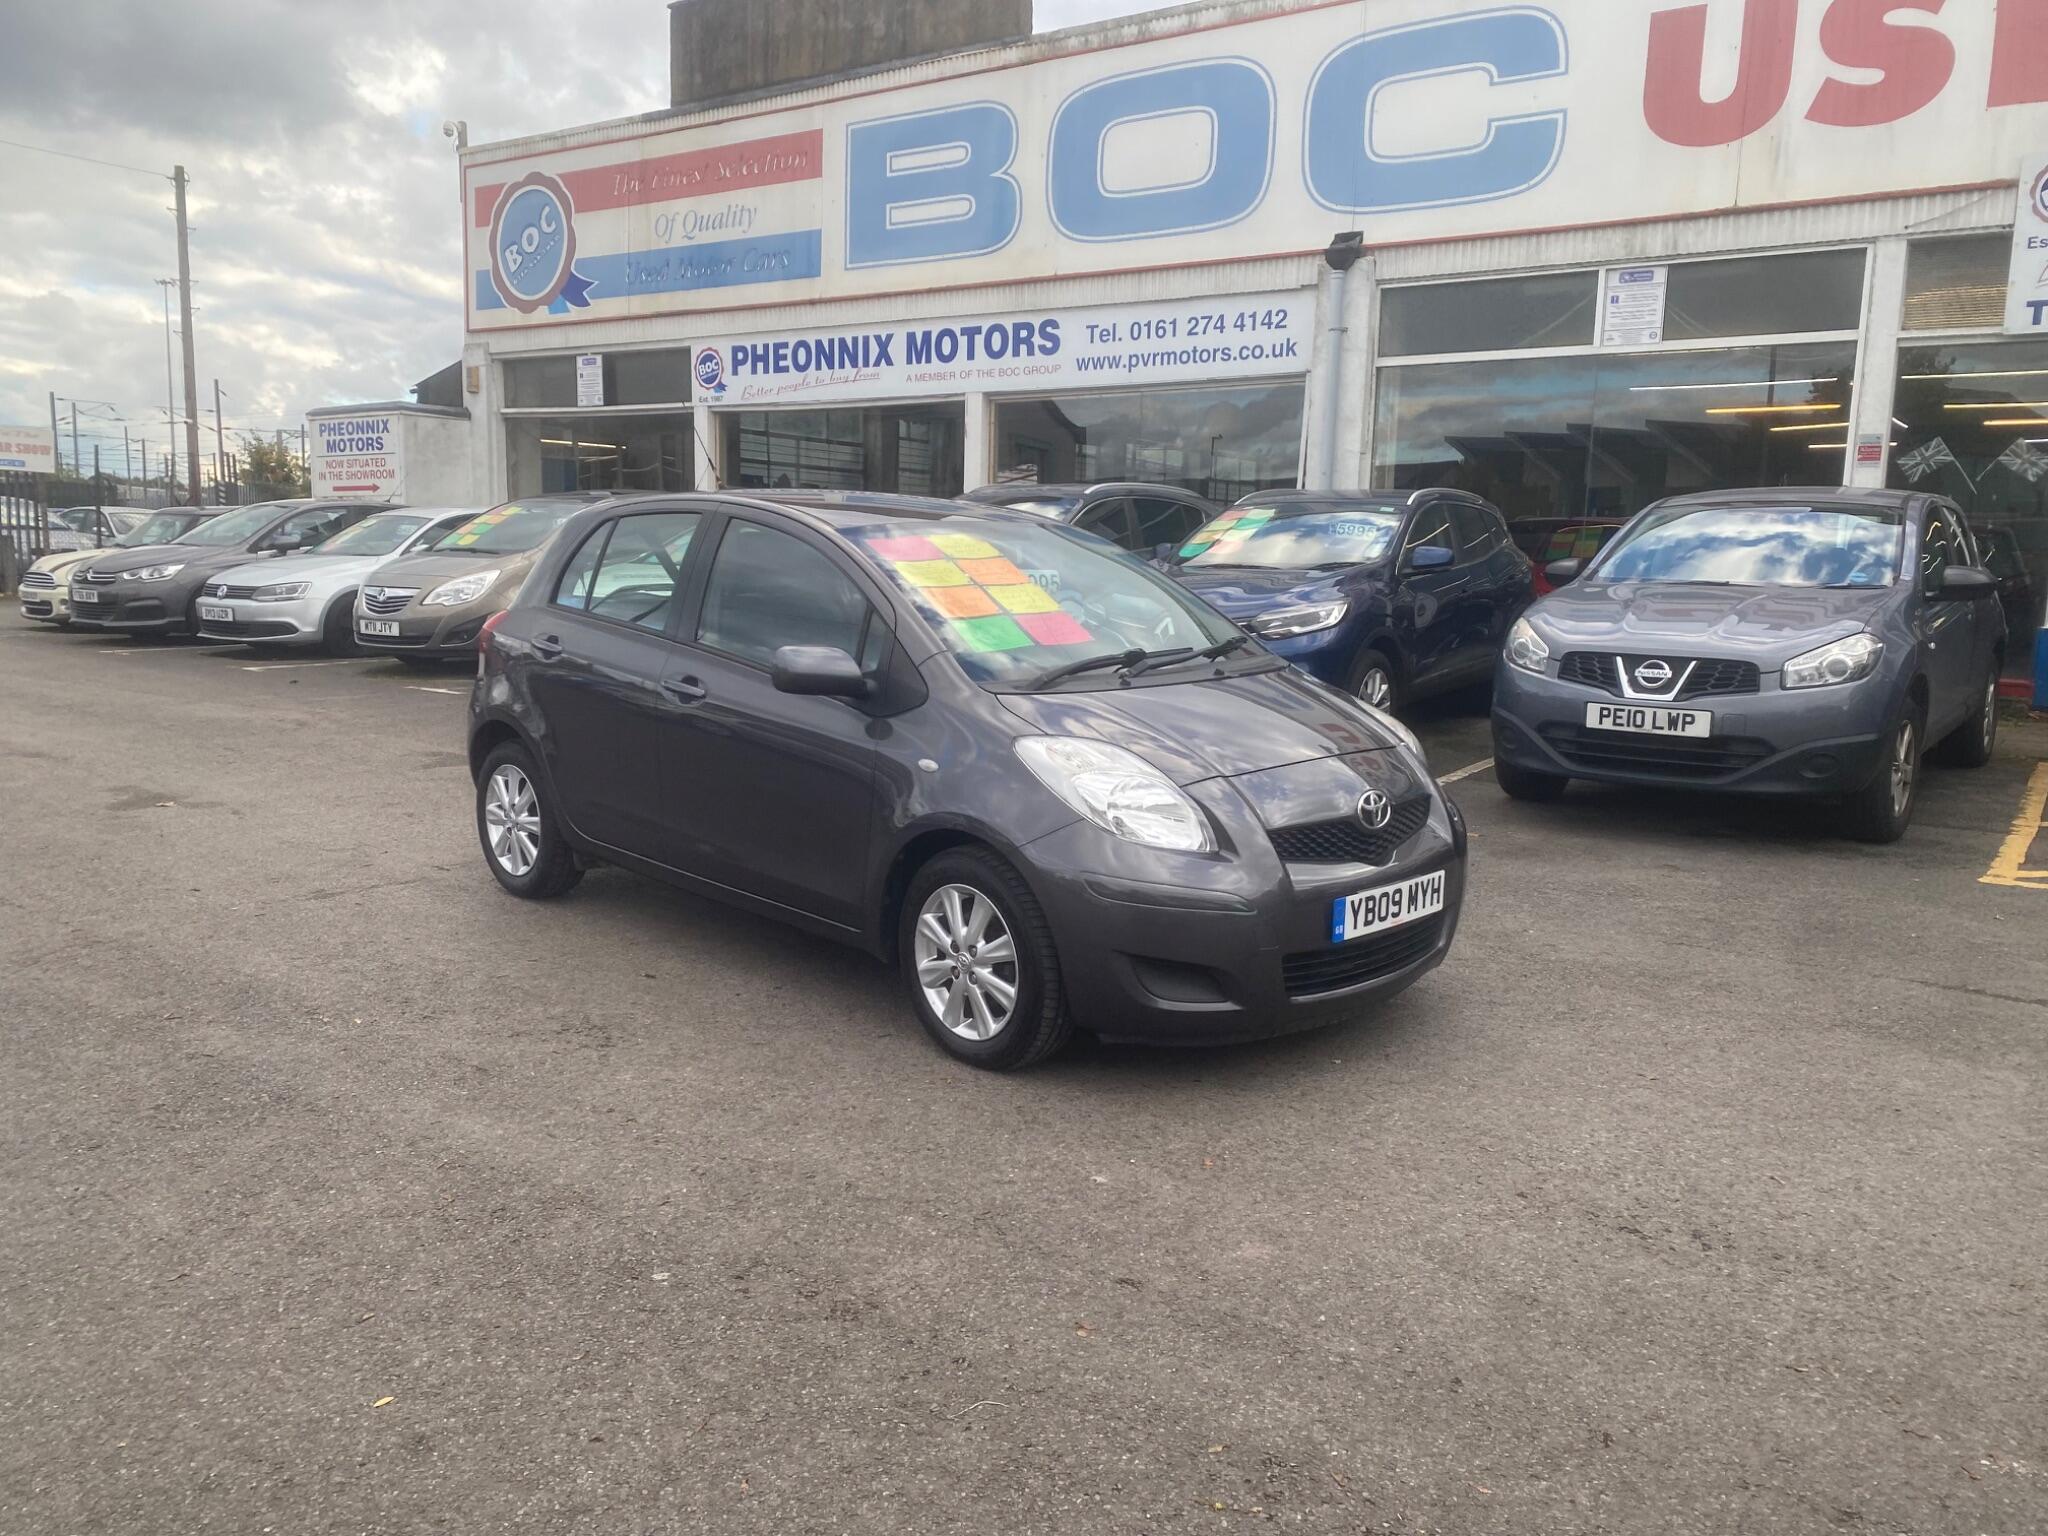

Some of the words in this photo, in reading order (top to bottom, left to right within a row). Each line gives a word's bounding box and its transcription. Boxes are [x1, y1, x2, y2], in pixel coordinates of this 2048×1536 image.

[846, 6, 1567, 269] BOC
[1643, 0, 2048, 147] US
[714, 150, 808, 180] Selection
[654, 211, 677, 243] Of
[682, 204, 757, 240] Quality
[505, 205, 556, 273] BOC
[625, 257, 670, 285] Used
[743, 248, 792, 272] Cars
[1086, 322, 1122, 344] Tel.
[1130, 318, 1177, 341] 0161
[1187, 313, 1226, 337] 274
[1233, 309, 1288, 332] 4142
[731, 333, 894, 376] PHEONNIX
[905, 319, 1060, 365] MOTORS
[1076, 338, 1297, 373] www.pvrmotors.co.uk
[698, 359, 719, 375] BOC
[905, 374, 912, 384] A
[914, 371, 955, 383] MEMBER
[959, 369, 974, 380] OF
[975, 368, 995, 378] THE
[998, 367, 1020, 377] BOC
[1023, 364, 1062, 376] GROUP
[740, 384, 774, 400] Better
[777, 377, 811, 395] people
[319, 418, 390, 437] PHEONNIX
[326, 435, 384, 453] MOTORS
[319, 471, 326, 481] IN
[328, 470, 343, 481] THE
[345, 468, 395, 480] SHOWROOM
[325, 459, 344, 469] NOW
[346, 457, 386, 469] SITUATED
[1599, 706, 1646, 729] PE10
[1651, 710, 1696, 732] LWP
[1350, 888, 1403, 930] YB09
[1407, 875, 1442, 914] MYH
